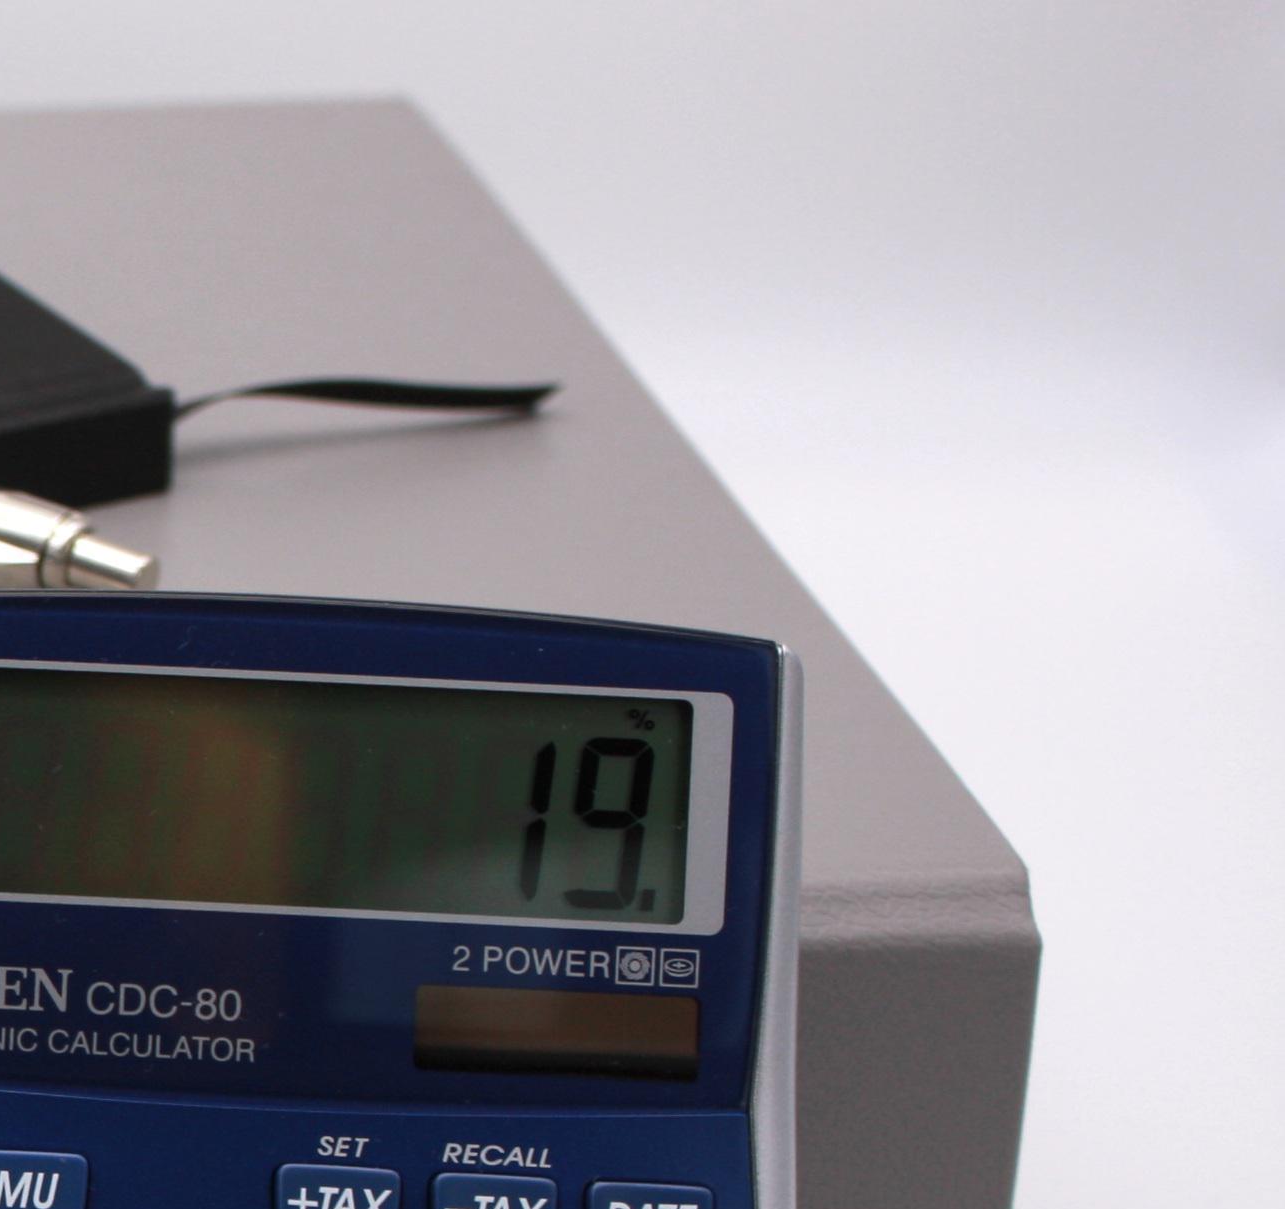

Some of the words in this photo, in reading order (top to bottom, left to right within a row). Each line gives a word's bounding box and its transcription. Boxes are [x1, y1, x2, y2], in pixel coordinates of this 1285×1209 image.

[452, 945, 471, 972] 2
[483, 945, 610, 979] POWER
[86, 981, 242, 1022] CDC-80
[47, 1028, 255, 1063] CALCULATOR
[317, 1135, 369, 1158] SET
[441, 1142, 553, 1168] RECALL
